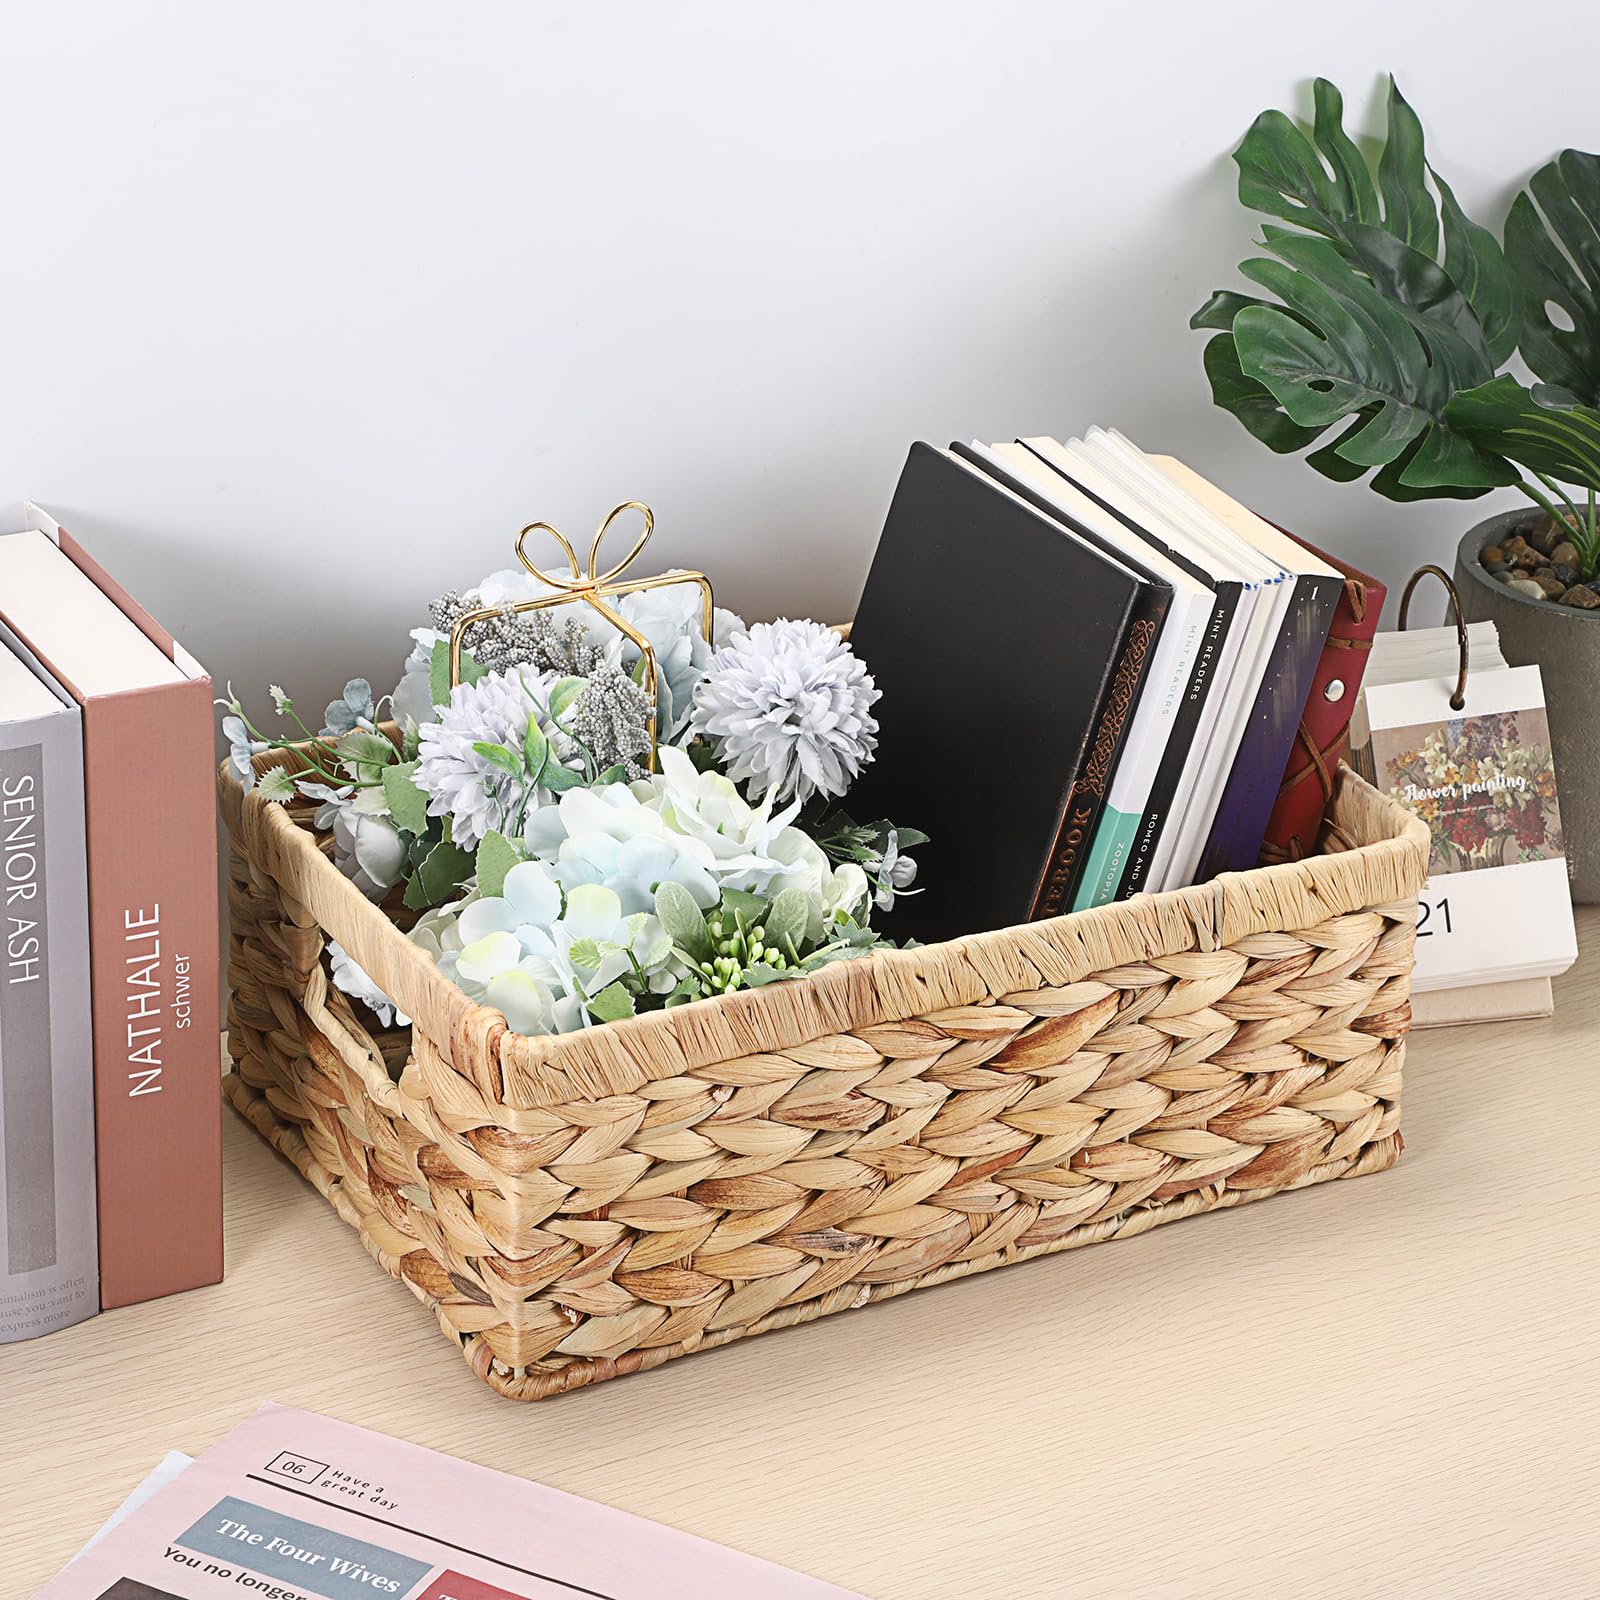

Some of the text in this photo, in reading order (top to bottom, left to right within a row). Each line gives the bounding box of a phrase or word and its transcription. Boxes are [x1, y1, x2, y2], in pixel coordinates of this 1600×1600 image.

[1162, 625, 1197, 715] MINT READERS
[1190, 609, 1224, 700] MINT READERS
[1463, 774, 1527, 800] painting
[1140, 813, 1158, 852] ROMEO
[2, 775, 40, 985] SENIOR ASH
[1100, 842, 1125, 900] ZOOTOPIA
[1131, 857, 1143, 880] AND
[125, 903, 162, 1098] NATHALIE
[171, 954, 190, 1028] schwer
[26, 1303, 46, 1316] you
[75, 1290, 85, 1300] to
[44, 1310, 71, 1324] more
[282, 1461, 306, 1474] 06
[332, 1470, 385, 1494] Have a
[320, 1479, 399, 1511] great day
[163, 1547, 202, 1568] You
[203, 1563, 232, 1578] no
[216, 1519, 401, 1593] The Four Wives
